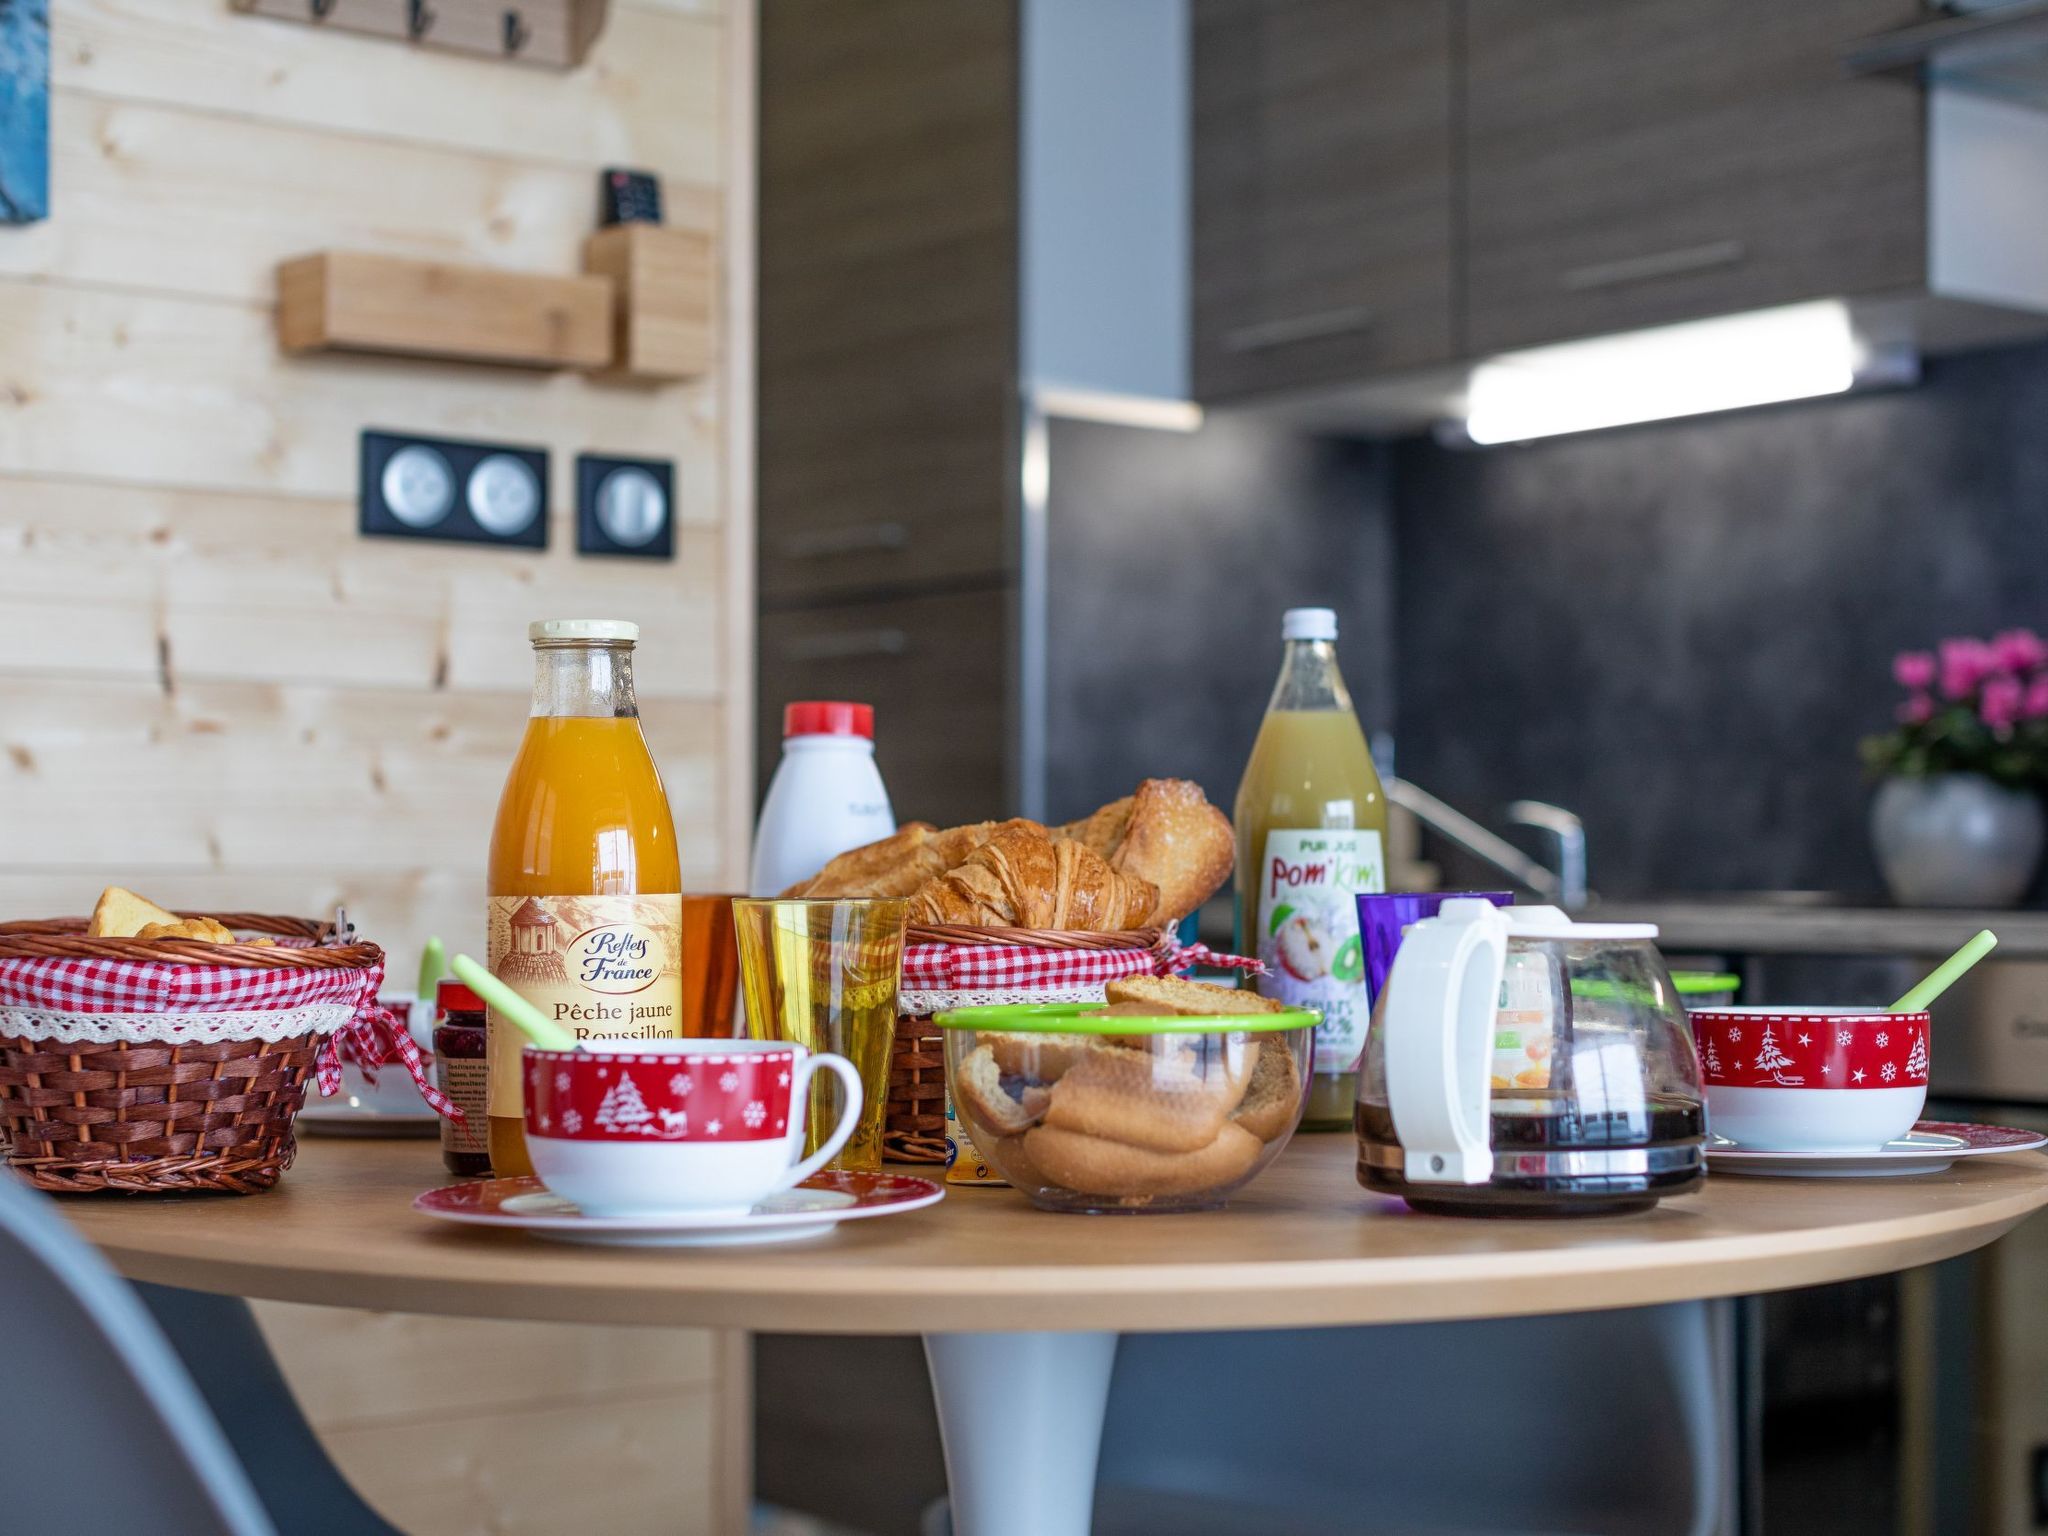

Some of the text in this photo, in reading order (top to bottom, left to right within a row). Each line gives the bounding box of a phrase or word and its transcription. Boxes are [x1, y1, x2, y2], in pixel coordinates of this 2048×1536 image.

[584, 932, 650, 959] Reflets
[580, 957, 652, 982] France
[617, 959, 628, 967] de
[553, 1002, 672, 1025] Pêche jaune
